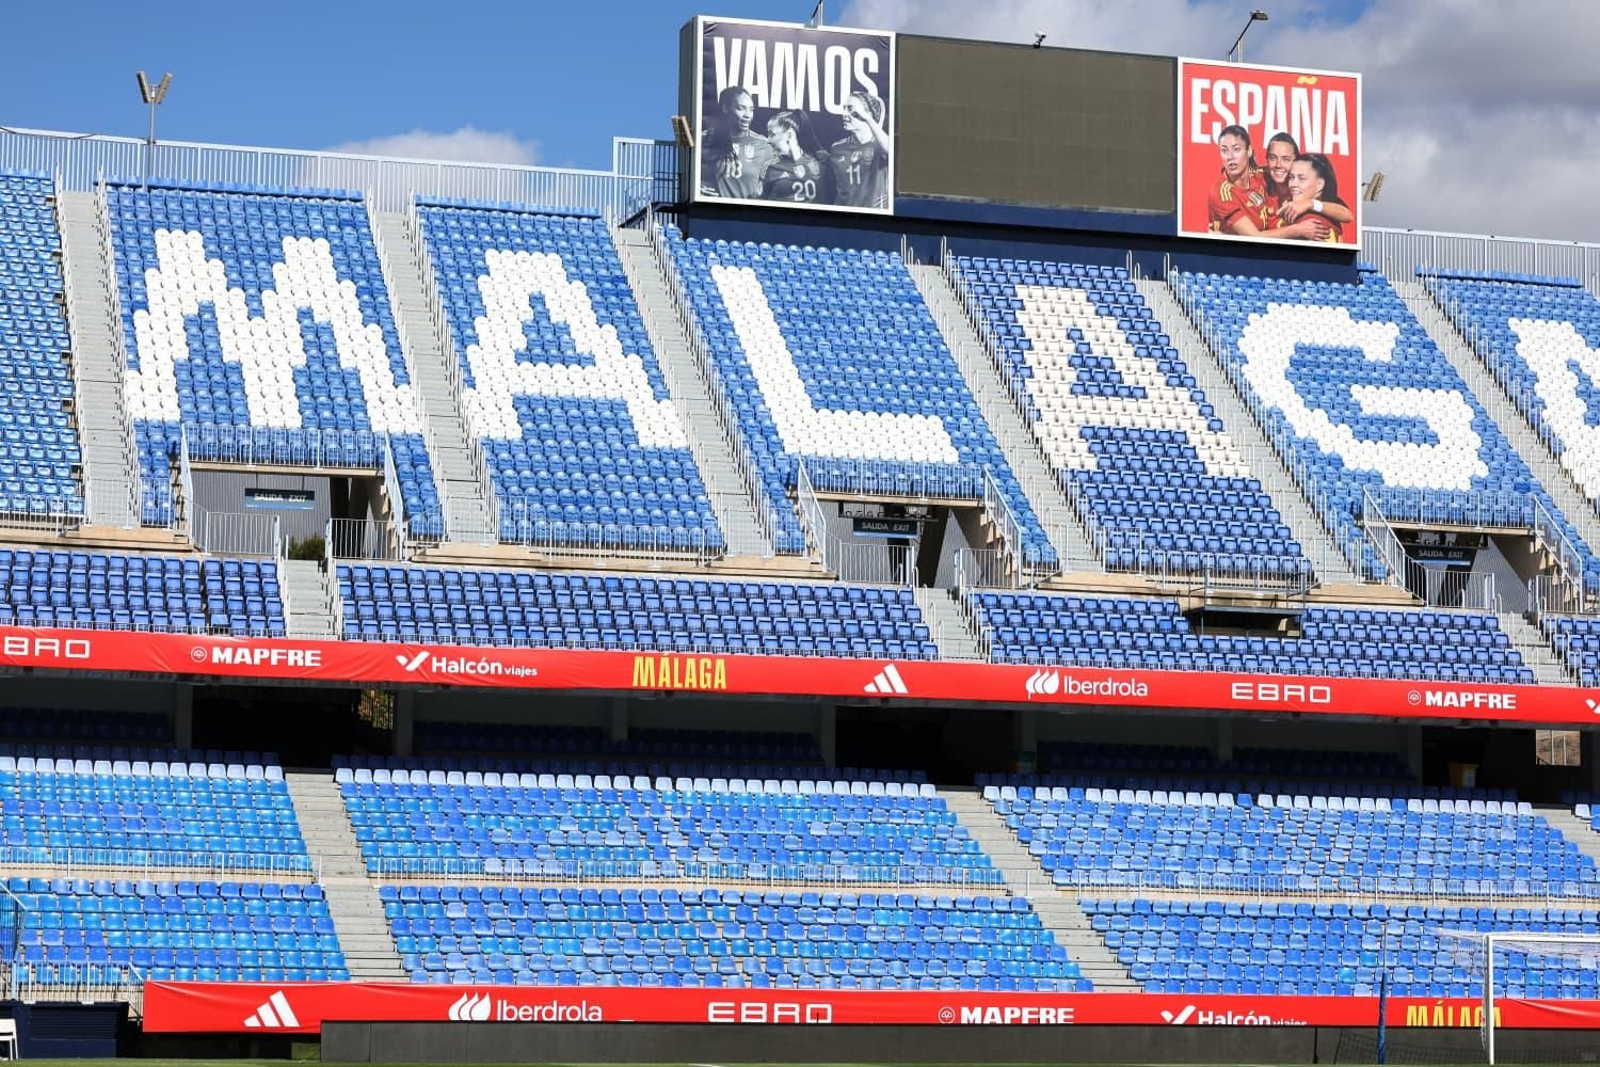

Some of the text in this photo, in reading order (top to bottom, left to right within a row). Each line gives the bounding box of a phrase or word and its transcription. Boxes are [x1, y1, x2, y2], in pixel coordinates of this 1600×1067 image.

[713, 36, 886, 127] VAMOS
[1191, 76, 1349, 155] ESPAÑA
[846, 164, 861, 185] 11
[792, 179, 817, 202] 20
[862, 521, 910, 532] SALIDA EXIT
[211, 646, 322, 667] MAPFRE
[431, 656, 538, 678] Halcón viajes
[632, 653, 728, 690] MÁLAGA
[1063, 675, 1149, 698] Iberdrola
[1231, 682, 1331, 704] EBRO
[1425, 690, 1517, 710] MAPFRE
[496, 1000, 603, 1022] Iberdrola
[708, 1001, 833, 1024] EBRO
[960, 1006, 1075, 1024] MAPFRE
